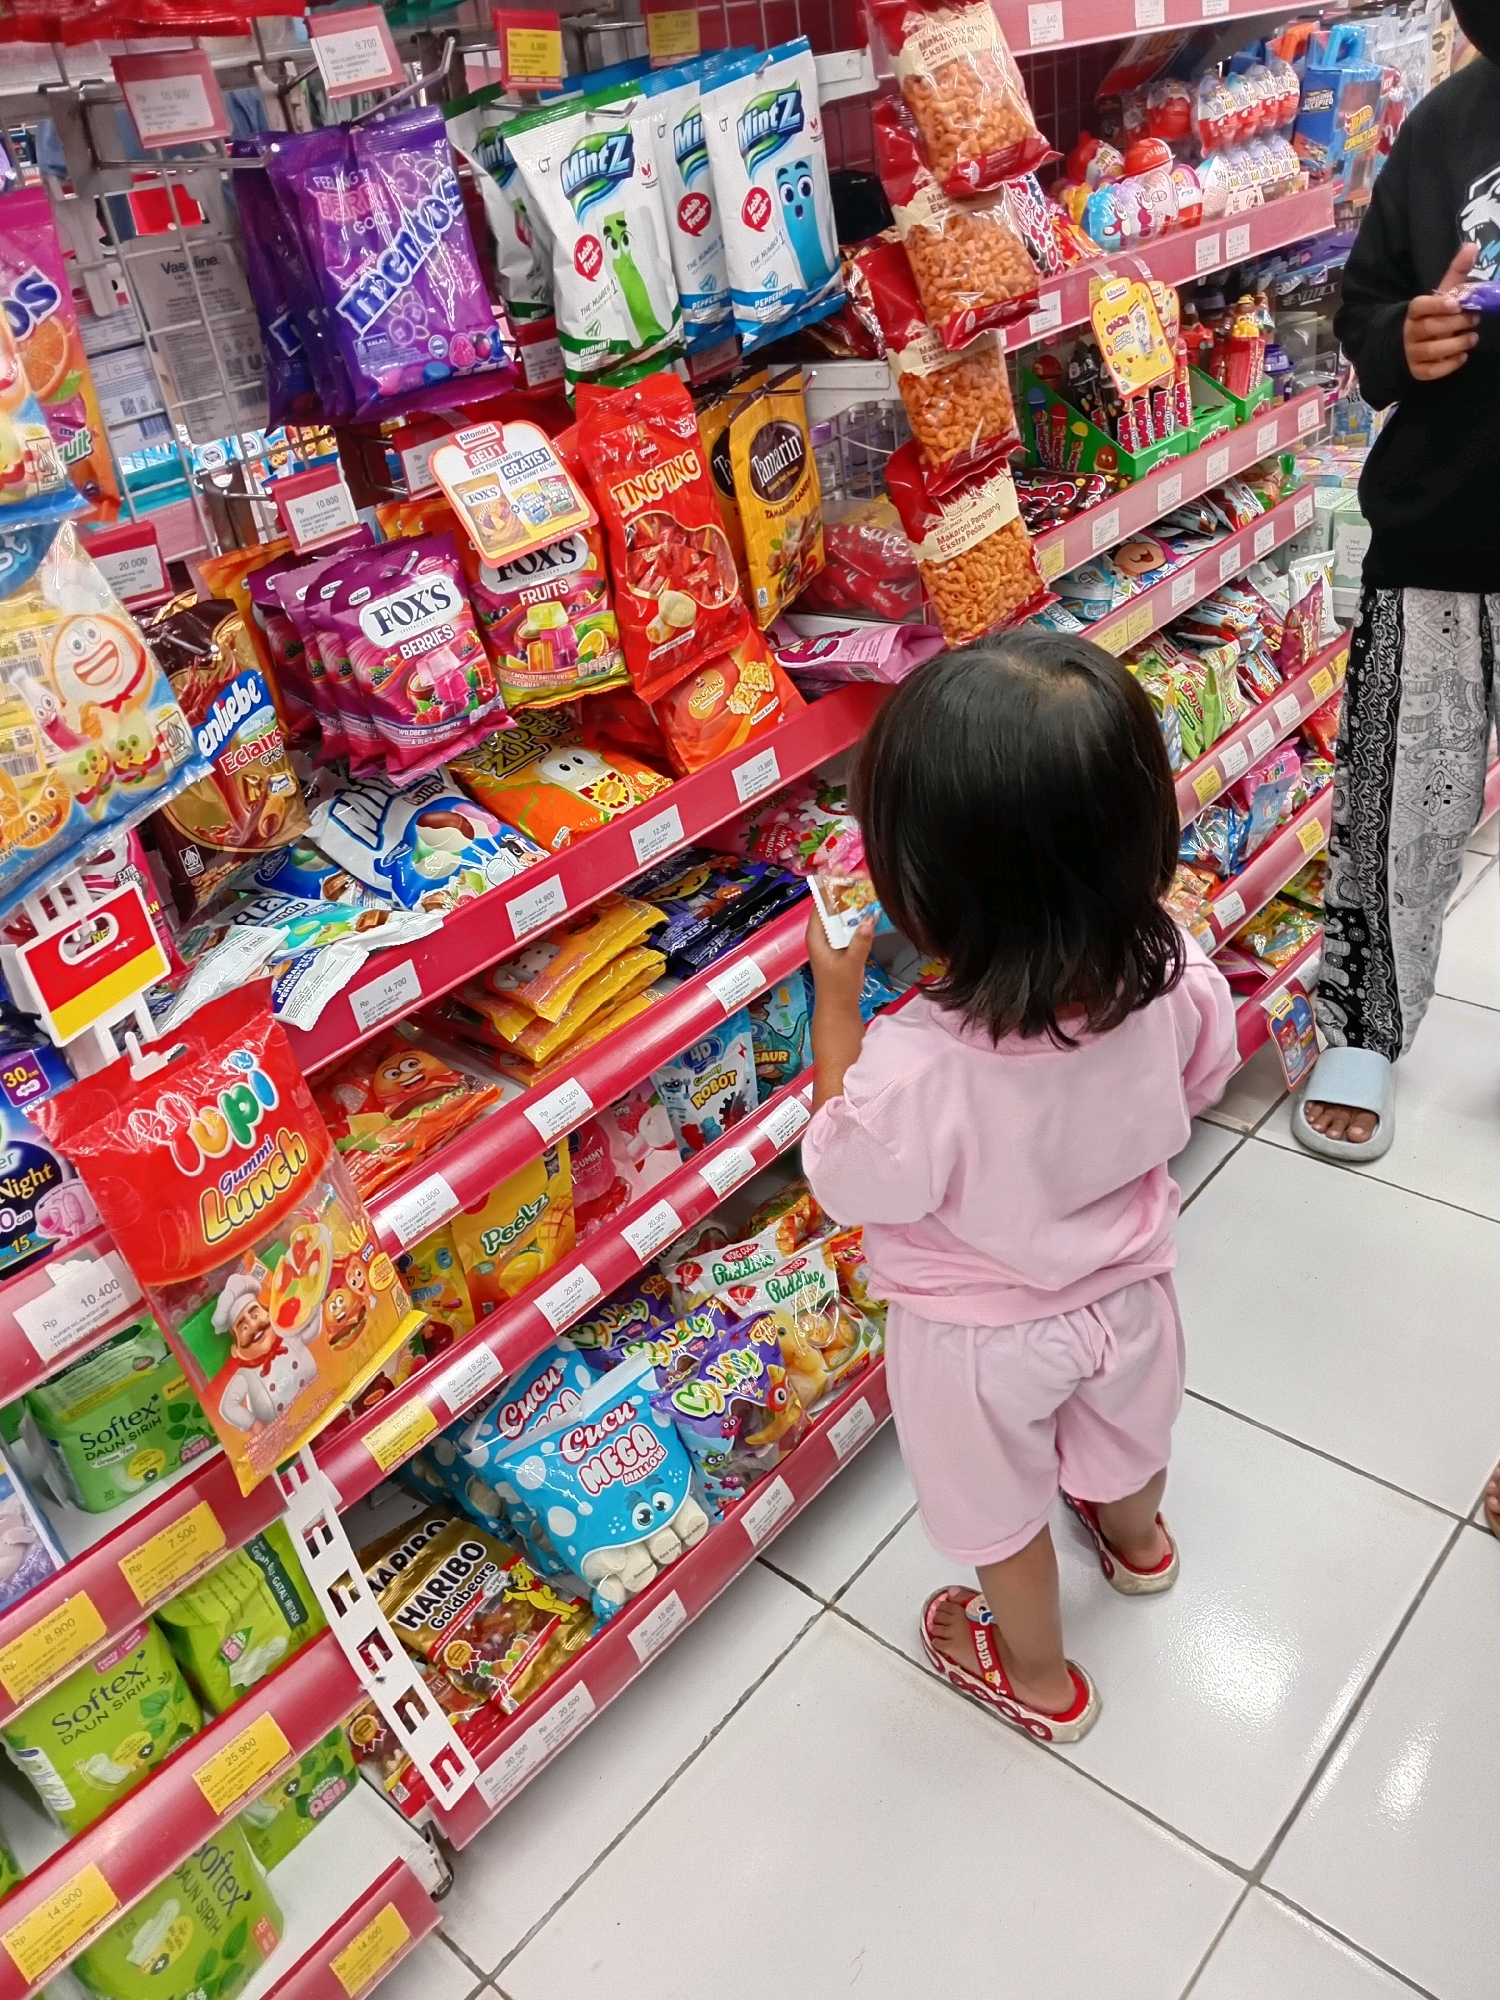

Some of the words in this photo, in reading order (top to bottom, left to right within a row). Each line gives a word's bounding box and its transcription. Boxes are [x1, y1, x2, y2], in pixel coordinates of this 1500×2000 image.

[354, 37, 378, 51] 9.700
[160, 255, 219, 275] Vasline
[459, 425, 494, 443] Alfamart
[468, 446, 495, 466] BELI
[503, 450, 543, 477] GRATIS
[751, 434, 803, 488] Tamarin
[295, 506, 305, 517] Rp
[936, 520, 971, 546] Makaroni
[970, 502, 1001, 526] Panggang
[940, 534, 967, 553] Ekstra
[966, 522, 986, 540] Pedas
[118, 555, 148, 572] 20.000
[369, 582, 452, 638] FOX'S
[518, 578, 570, 607] FRUITS
[399, 623, 456, 661] BERRIES
[198, 675, 263, 758] enliebe
[218, 726, 285, 777] Eclairs
[652, 821, 672, 837] 12.300
[275, 951, 310, 996] JUARANYA
[276, 970, 302, 1005] PERMEN
[359, 999, 370, 1009] Rp
[382, 976, 408, 996] 14.700
[690, 1040, 712, 1061] 4D
[690, 1069, 738, 1111] ROBOT
[693, 1063, 722, 1087] Gummy
[168, 1050, 279, 1177] Yupi
[539, 1110, 549, 1119] Rp
[558, 1088, 580, 1106] 15.200
[218, 1137, 275, 1197] Gummi
[571, 1146, 605, 1172] GUMMY
[199, 1128, 310, 1244] Lunch
[393, 1211, 404, 1222] Rp
[631, 1231, 640, 1241] Rp
[647, 1209, 668, 1229] 20.900
[42, 1318, 58, 1332] Rp
[80, 1278, 120, 1309] 10.400
[546, 1300, 555, 1309] Rp
[563, 1275, 585, 1297] 20.900
[765, 1269, 826, 1304] Pudding
[447, 1378, 457, 1389] Rp
[467, 1352, 490, 1374] 18.500
[79, 1393, 161, 1452] Softex
[85, 1438, 126, 1462] DAUN
[128, 1416, 162, 1441] SIRIH
[370, 1438, 381, 1449] Rp
[392, 1409, 417, 1431] 10.000
[559, 1399, 638, 1465] Cucu
[577, 1424, 658, 1497] MEGA
[622, 1446, 669, 1487] MALLOW
[128, 1563, 143, 1575] Rp
[167, 1523, 197, 1549] 7.500
[395, 1540, 488, 1631] HARIBO
[428, 1561, 498, 1631] Goldbears
[44, 1617, 76, 1645] 8.900
[284, 1598, 301, 1624] IRITASI
[639, 1629, 649, 1640] Rp
[51, 1650, 147, 1738] Softex
[60, 1712, 111, 1747] DAUN
[112, 1675, 153, 1714] SIRIH
[538, 1724, 548, 1736] Rp
[557, 1694, 582, 1718] 20.500
[200, 1773, 213, 1787] Rp
[225, 1736, 258, 1768] 25.900
[484, 1777, 494, 1787] Rp
[504, 1744, 529, 1769] 20.500
[11, 1936, 27, 1950] Rp
[47, 1887, 83, 1921] 14.900
[195, 1896, 224, 1938] SIRIH
[336, 1961, 347, 1974] Rp
[357, 1925, 383, 1953] 14.500
